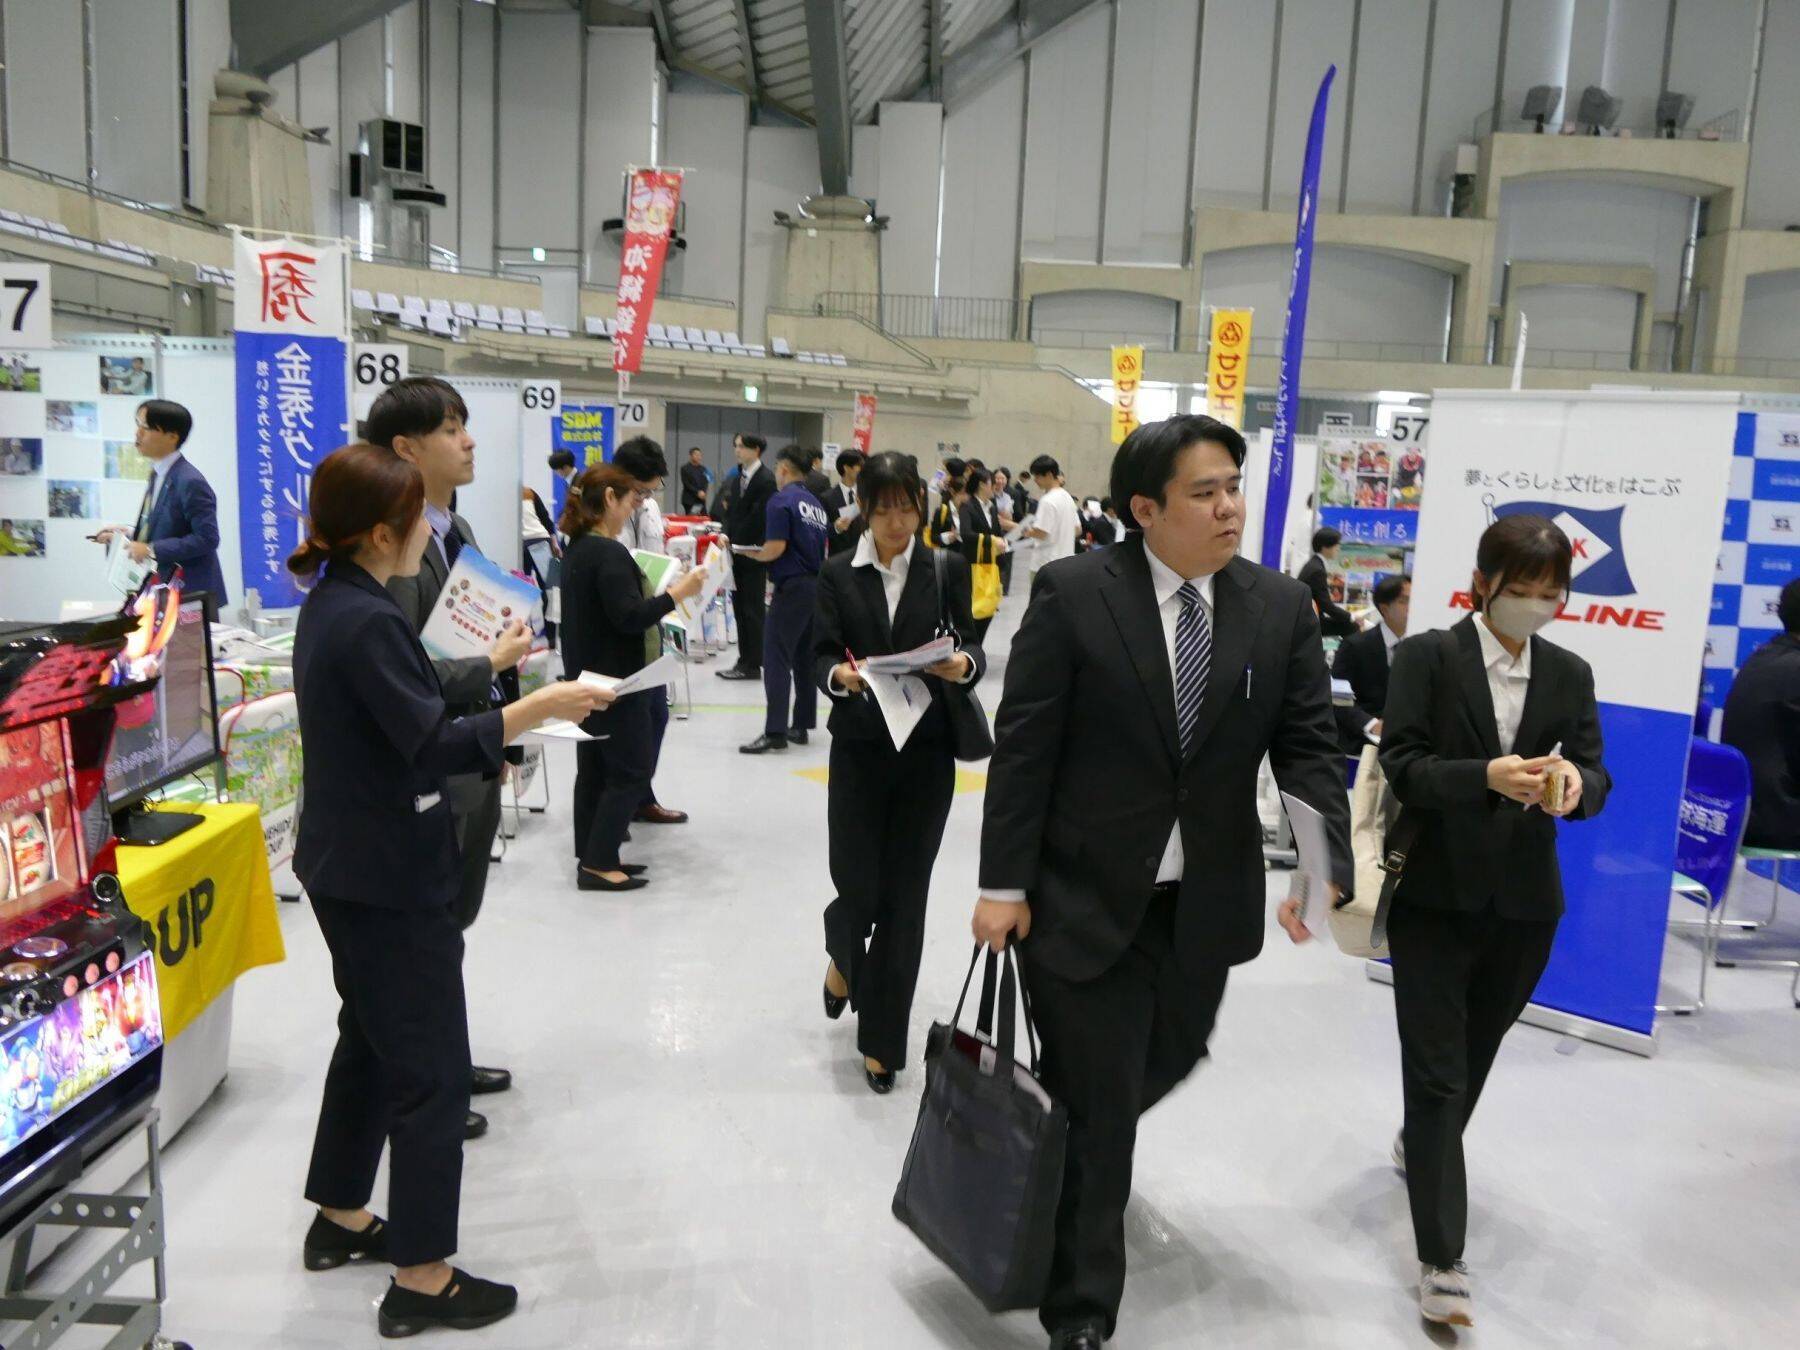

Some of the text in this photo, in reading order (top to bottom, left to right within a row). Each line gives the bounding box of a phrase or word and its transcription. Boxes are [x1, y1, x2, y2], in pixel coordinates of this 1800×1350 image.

[0, 279, 38, 331] 7
[356, 353, 400, 385] 68
[522, 387, 556, 409] 69
[561, 411, 603, 429] SBM
[619, 403, 644, 421] 70
[1393, 416, 1429, 442] 57
[1463, 469, 1683, 497] 夢とくらしと文化をはこぶ
